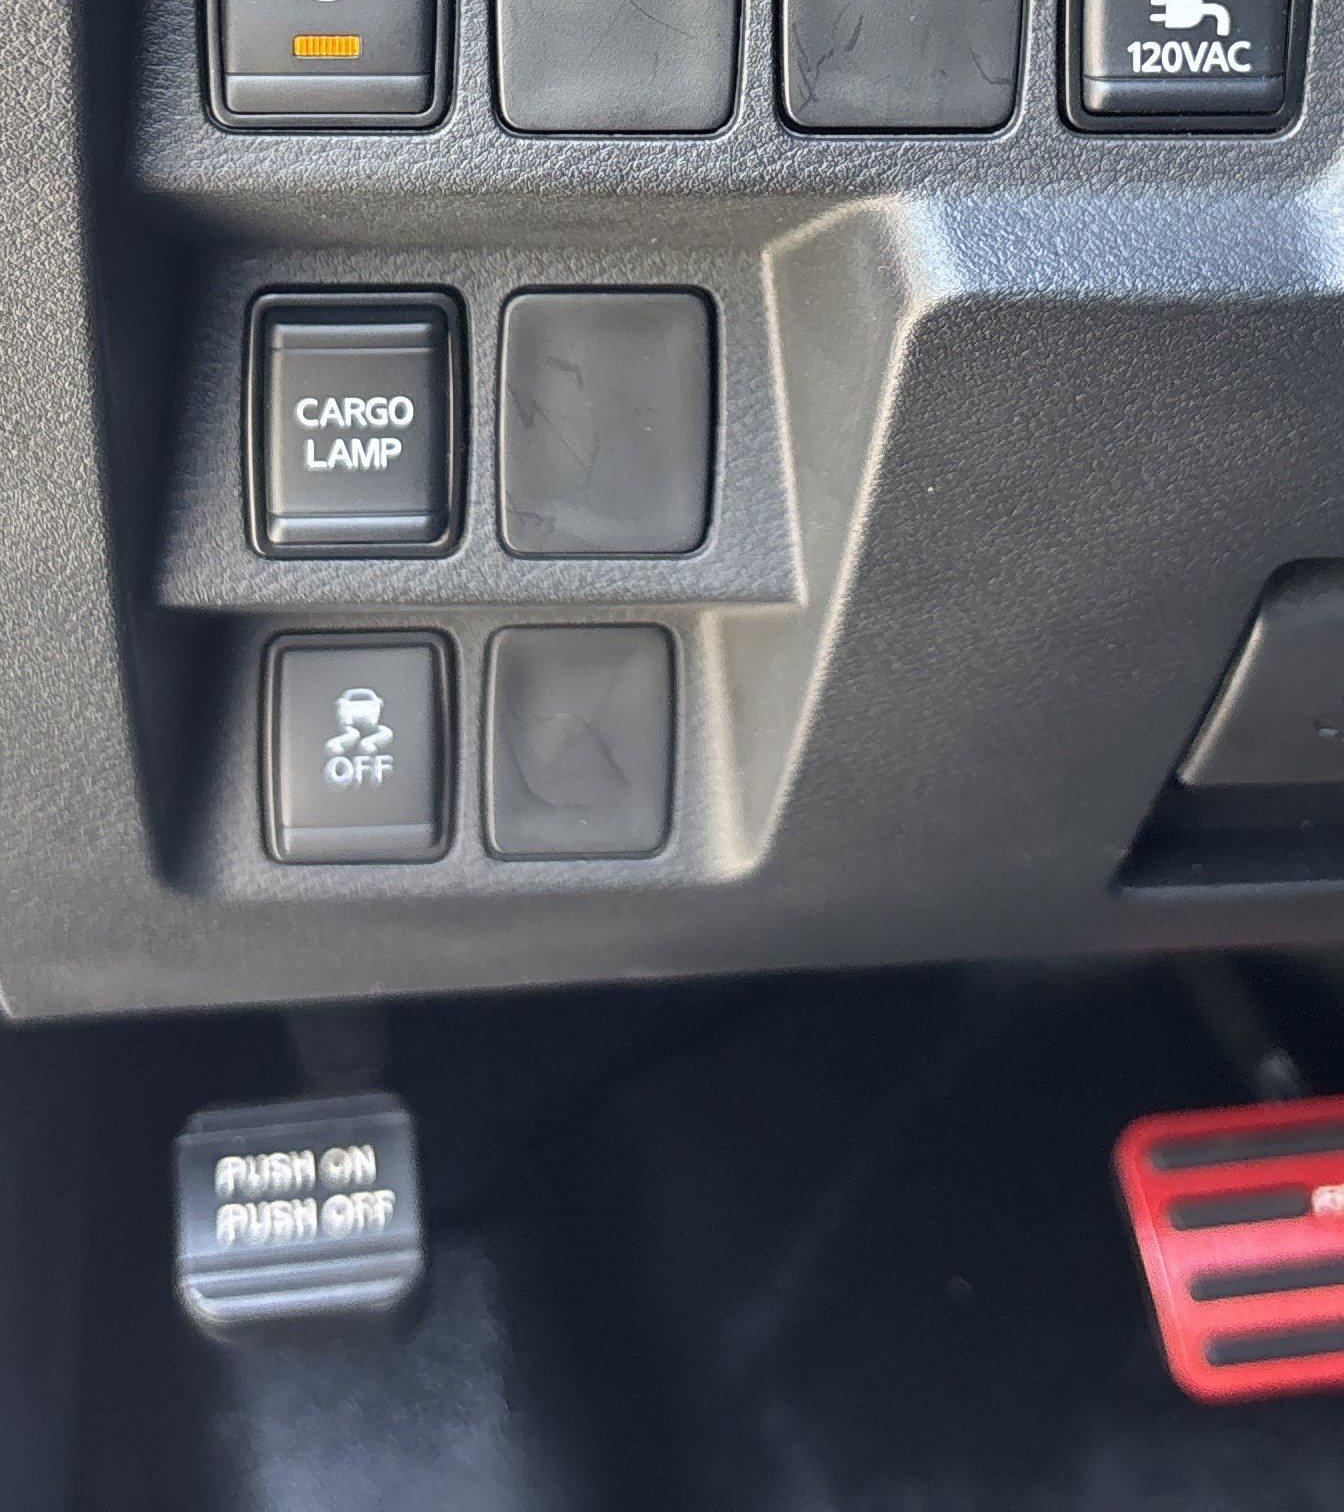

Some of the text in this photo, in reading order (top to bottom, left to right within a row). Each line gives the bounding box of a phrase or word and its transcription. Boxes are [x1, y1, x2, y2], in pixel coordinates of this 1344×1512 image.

[1126, 40, 1252, 74] 120VAC
[295, 395, 414, 428] CARGO
[305, 437, 403, 470] LAMP
[324, 754, 394, 786] OFF
[214, 1143, 378, 1202] PUSH ON
[215, 1188, 397, 1251] PUSH OFF
